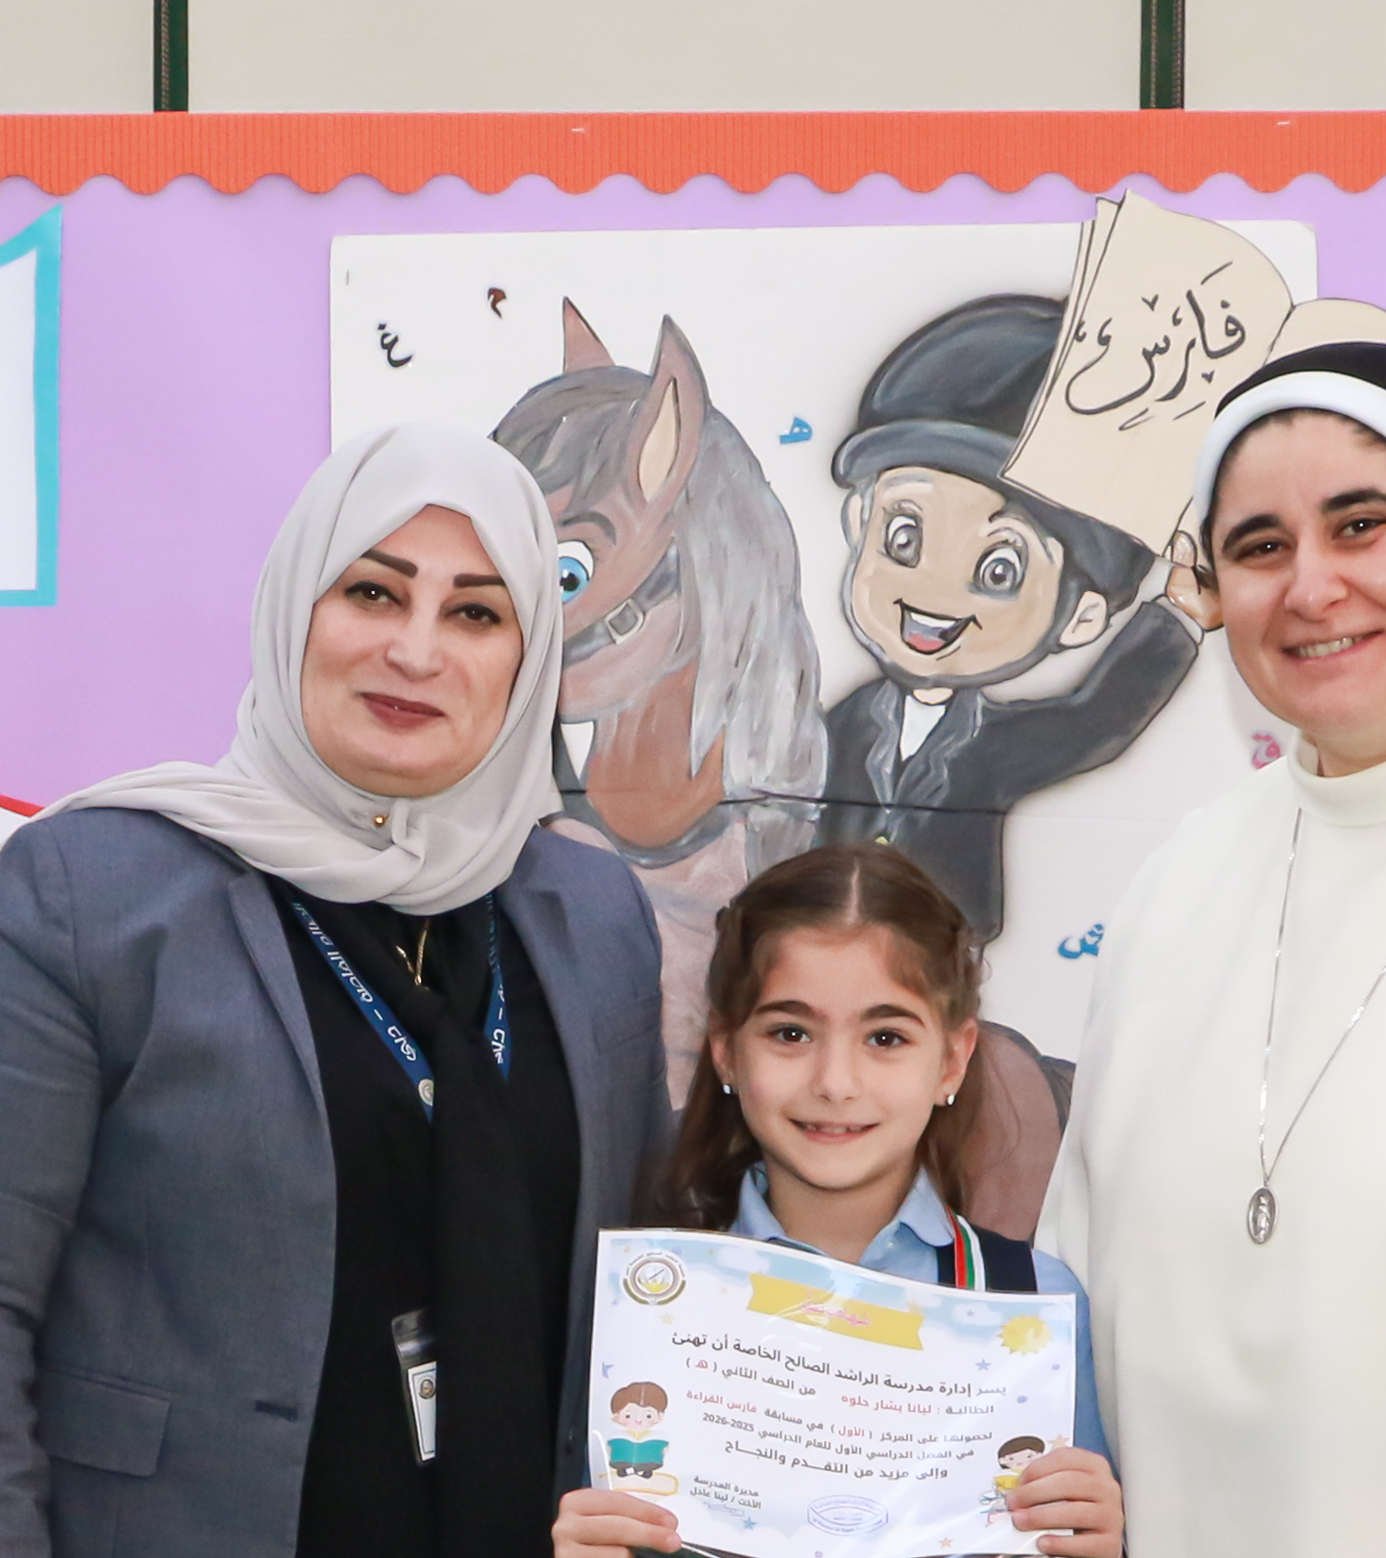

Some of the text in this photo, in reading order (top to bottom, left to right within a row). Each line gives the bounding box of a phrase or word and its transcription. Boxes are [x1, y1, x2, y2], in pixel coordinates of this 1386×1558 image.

[711, 1333, 729, 1351] أن
[733, 1338, 781, 1362] الخاصة
[784, 1355, 830, 1375] الصالح
[761, 1375, 795, 1390] الصف
[835, 1368, 879, 1386] الراشد
[883, 1374, 934, 1393] مدرسة
[798, 1384, 817, 1396] من
[939, 1381, 972, 1397] إدارة
[853, 1467, 874, 1479] من
